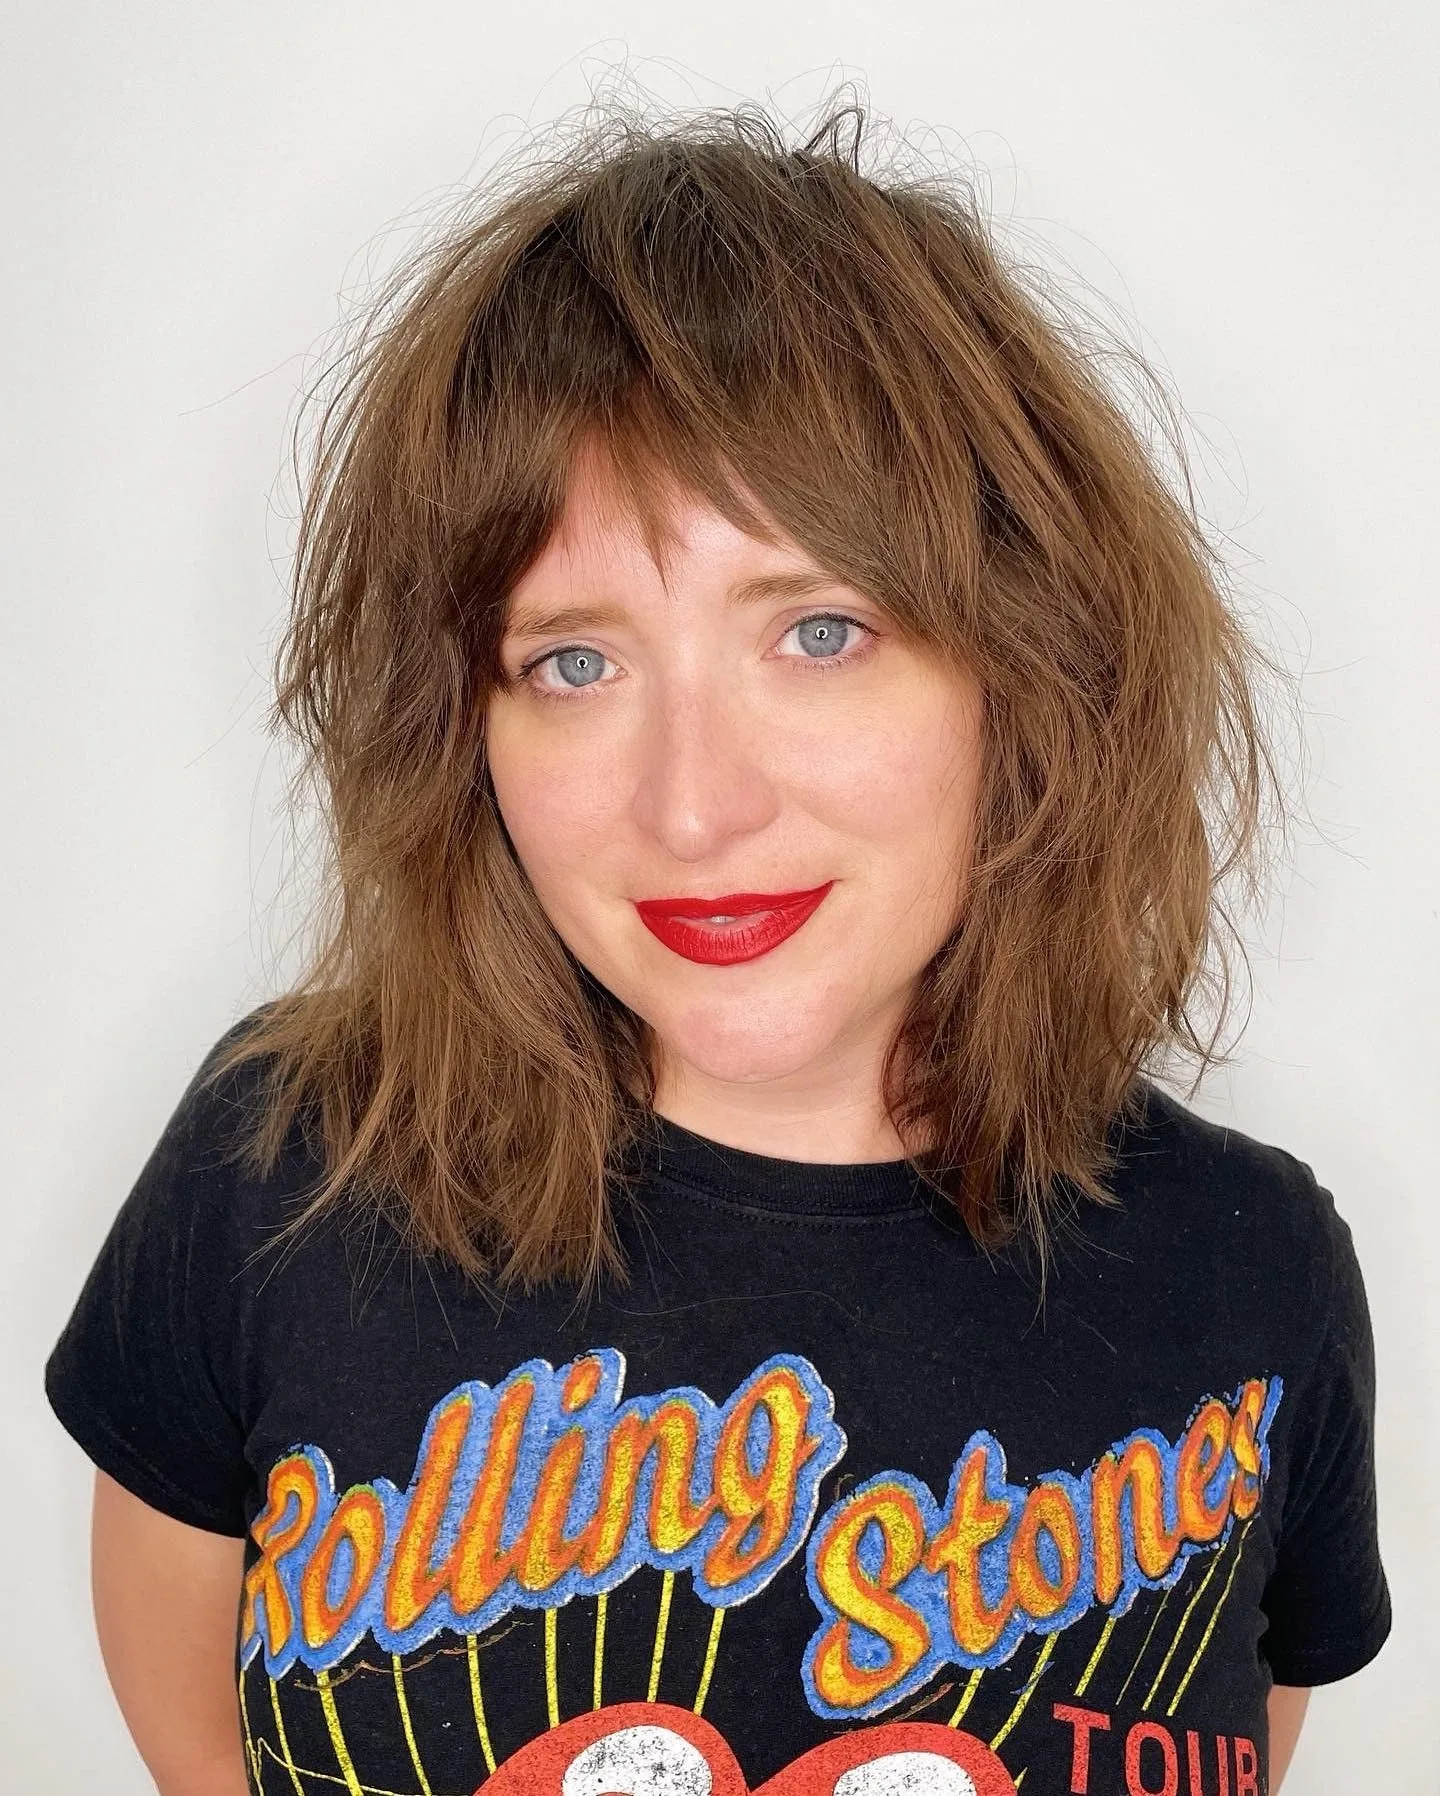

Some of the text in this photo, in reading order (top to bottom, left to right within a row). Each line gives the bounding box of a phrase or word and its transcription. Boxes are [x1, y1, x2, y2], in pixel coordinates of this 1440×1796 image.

[241, 1349, 1282, 1717] Rolling Stones
[1053, 1702, 1260, 1796] TOUR
